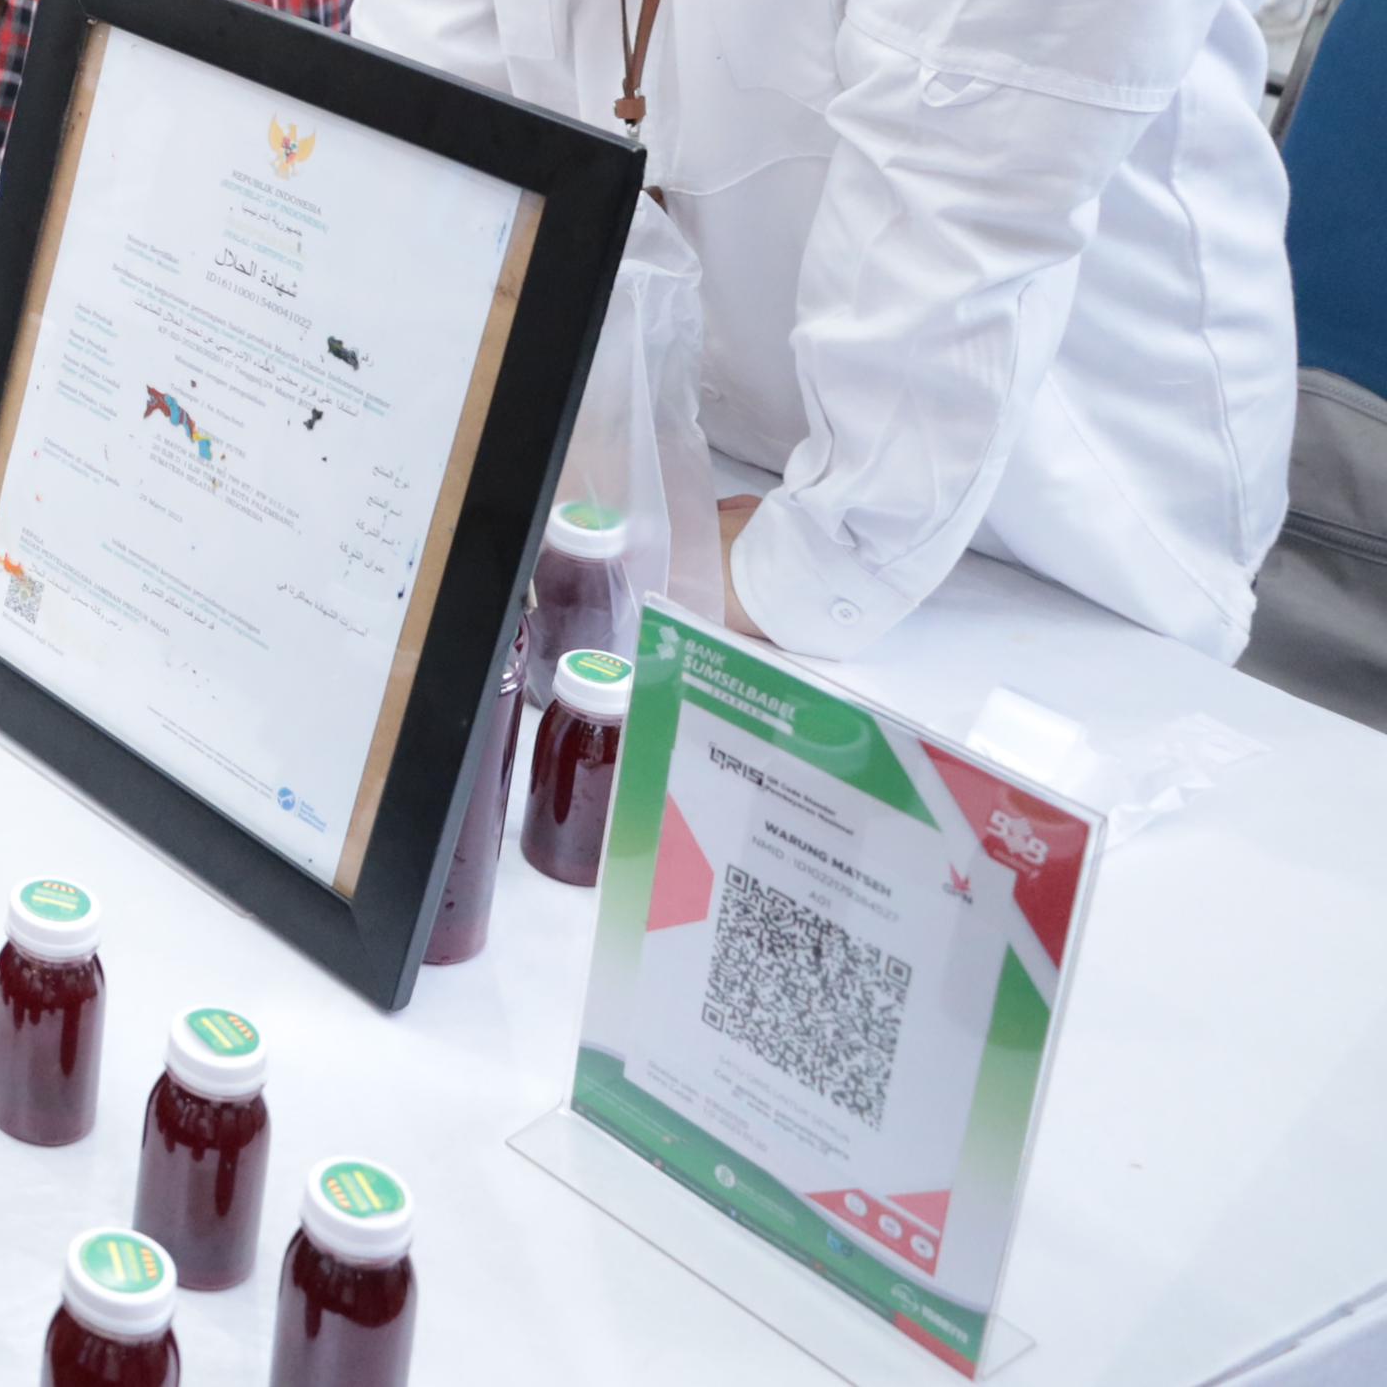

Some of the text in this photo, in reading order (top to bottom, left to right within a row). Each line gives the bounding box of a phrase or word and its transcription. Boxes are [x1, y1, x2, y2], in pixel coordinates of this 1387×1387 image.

[232, 170, 322, 215] REPUBLIK INDONESIA
[214, 248, 257, 278] الحلال
[684, 636, 726, 670] BANK
[682, 651, 797, 723] SUMSELBABEL
[708, 745, 764, 790] QRIS
[763, 819, 828, 864] WARUNG
